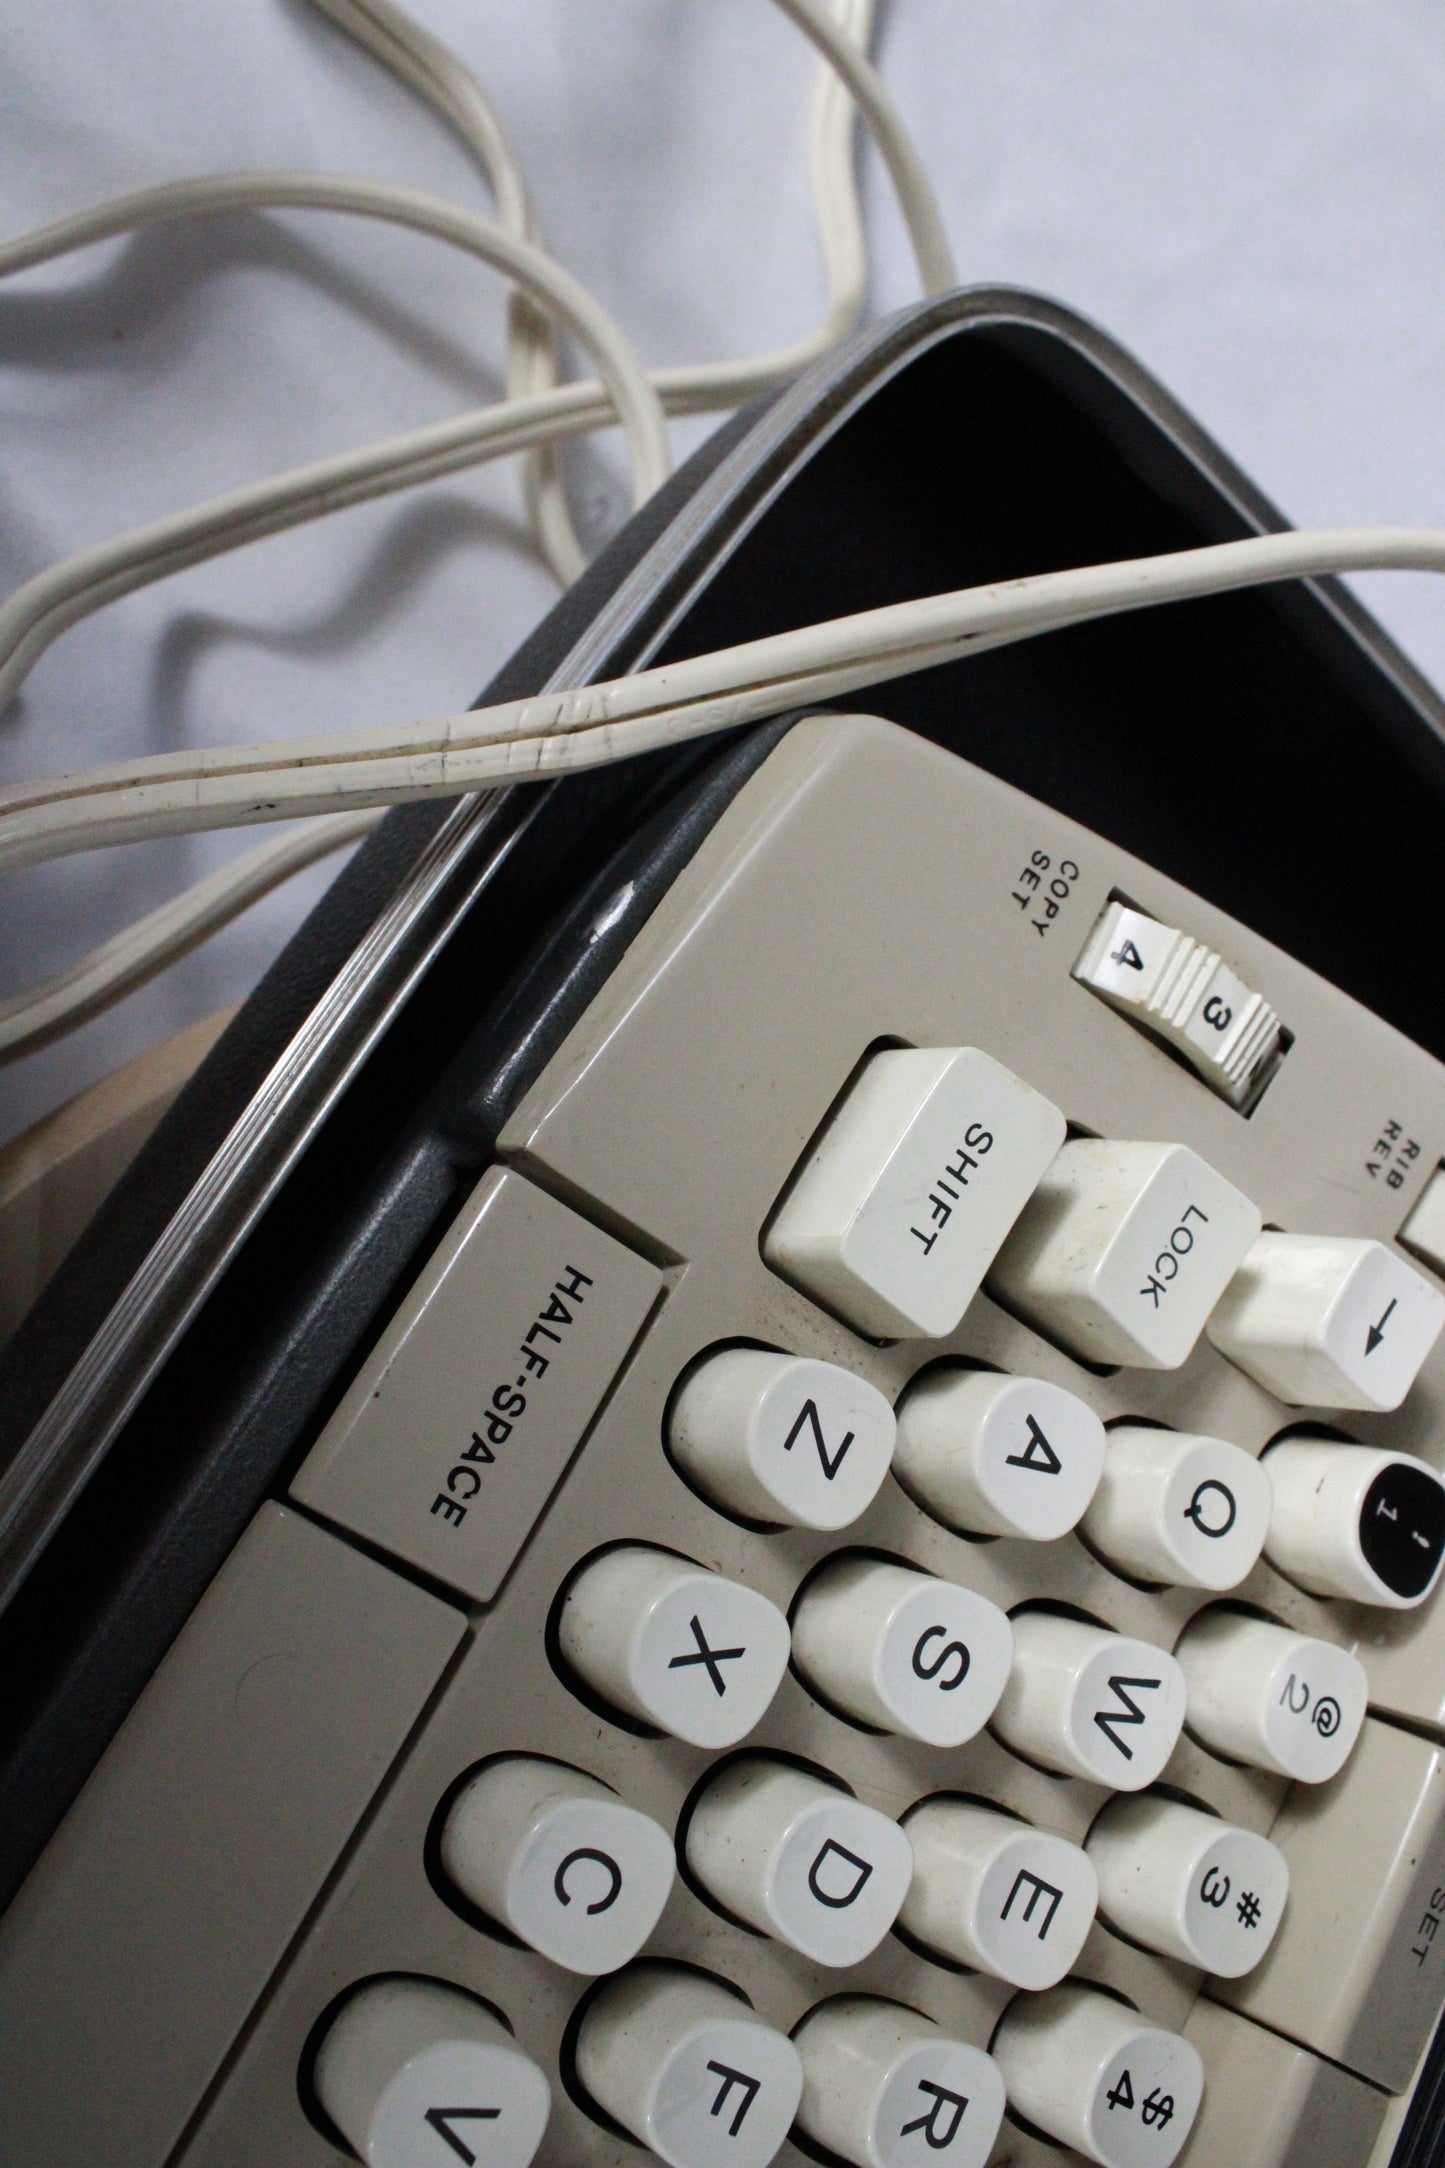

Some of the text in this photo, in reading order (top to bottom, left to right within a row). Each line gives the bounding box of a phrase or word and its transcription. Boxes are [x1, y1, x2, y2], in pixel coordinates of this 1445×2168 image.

[1010, 850, 1051, 911] SET
[1031, 859, 1080, 937] COPY
[1110, 939, 1144, 971] 4
[1203, 996, 1233, 1031] 3
[1365, 1120, 1403, 1178] REV
[1386, 1138, 1421, 1189] RIB
[908, 1122, 995, 1256] SHIFT
[1139, 1204, 1210, 1309] LOCK
[429, 1264, 594, 1528] HALF-SPACE
[783, 1398, 855, 1480] Z
[1005, 1413, 1062, 1475] A
[1183, 1479, 1237, 1539] Q
[1376, 1498, 1398, 1521] 1
[668, 1615, 747, 1697] X
[911, 1625, 971, 1691] S
[1093, 1676, 1162, 1761] W
[1279, 1673, 1310, 1714] 2
[1312, 1696, 1341, 1738] @
[553, 1848, 622, 1915] C
[808, 1838, 874, 1909] D
[1000, 1868, 1064, 1941] E
[1200, 1866, 1231, 1909] 3
[1236, 1890, 1262, 1930] #
[1410, 1886, 1445, 1969] SET
[706, 2059, 762, 2137] F
[900, 2079, 969, 2149] R
[1106, 2069, 1136, 2111] 4
[1141, 2086, 1175, 2132] $
[423, 2107, 502, 2168] V
